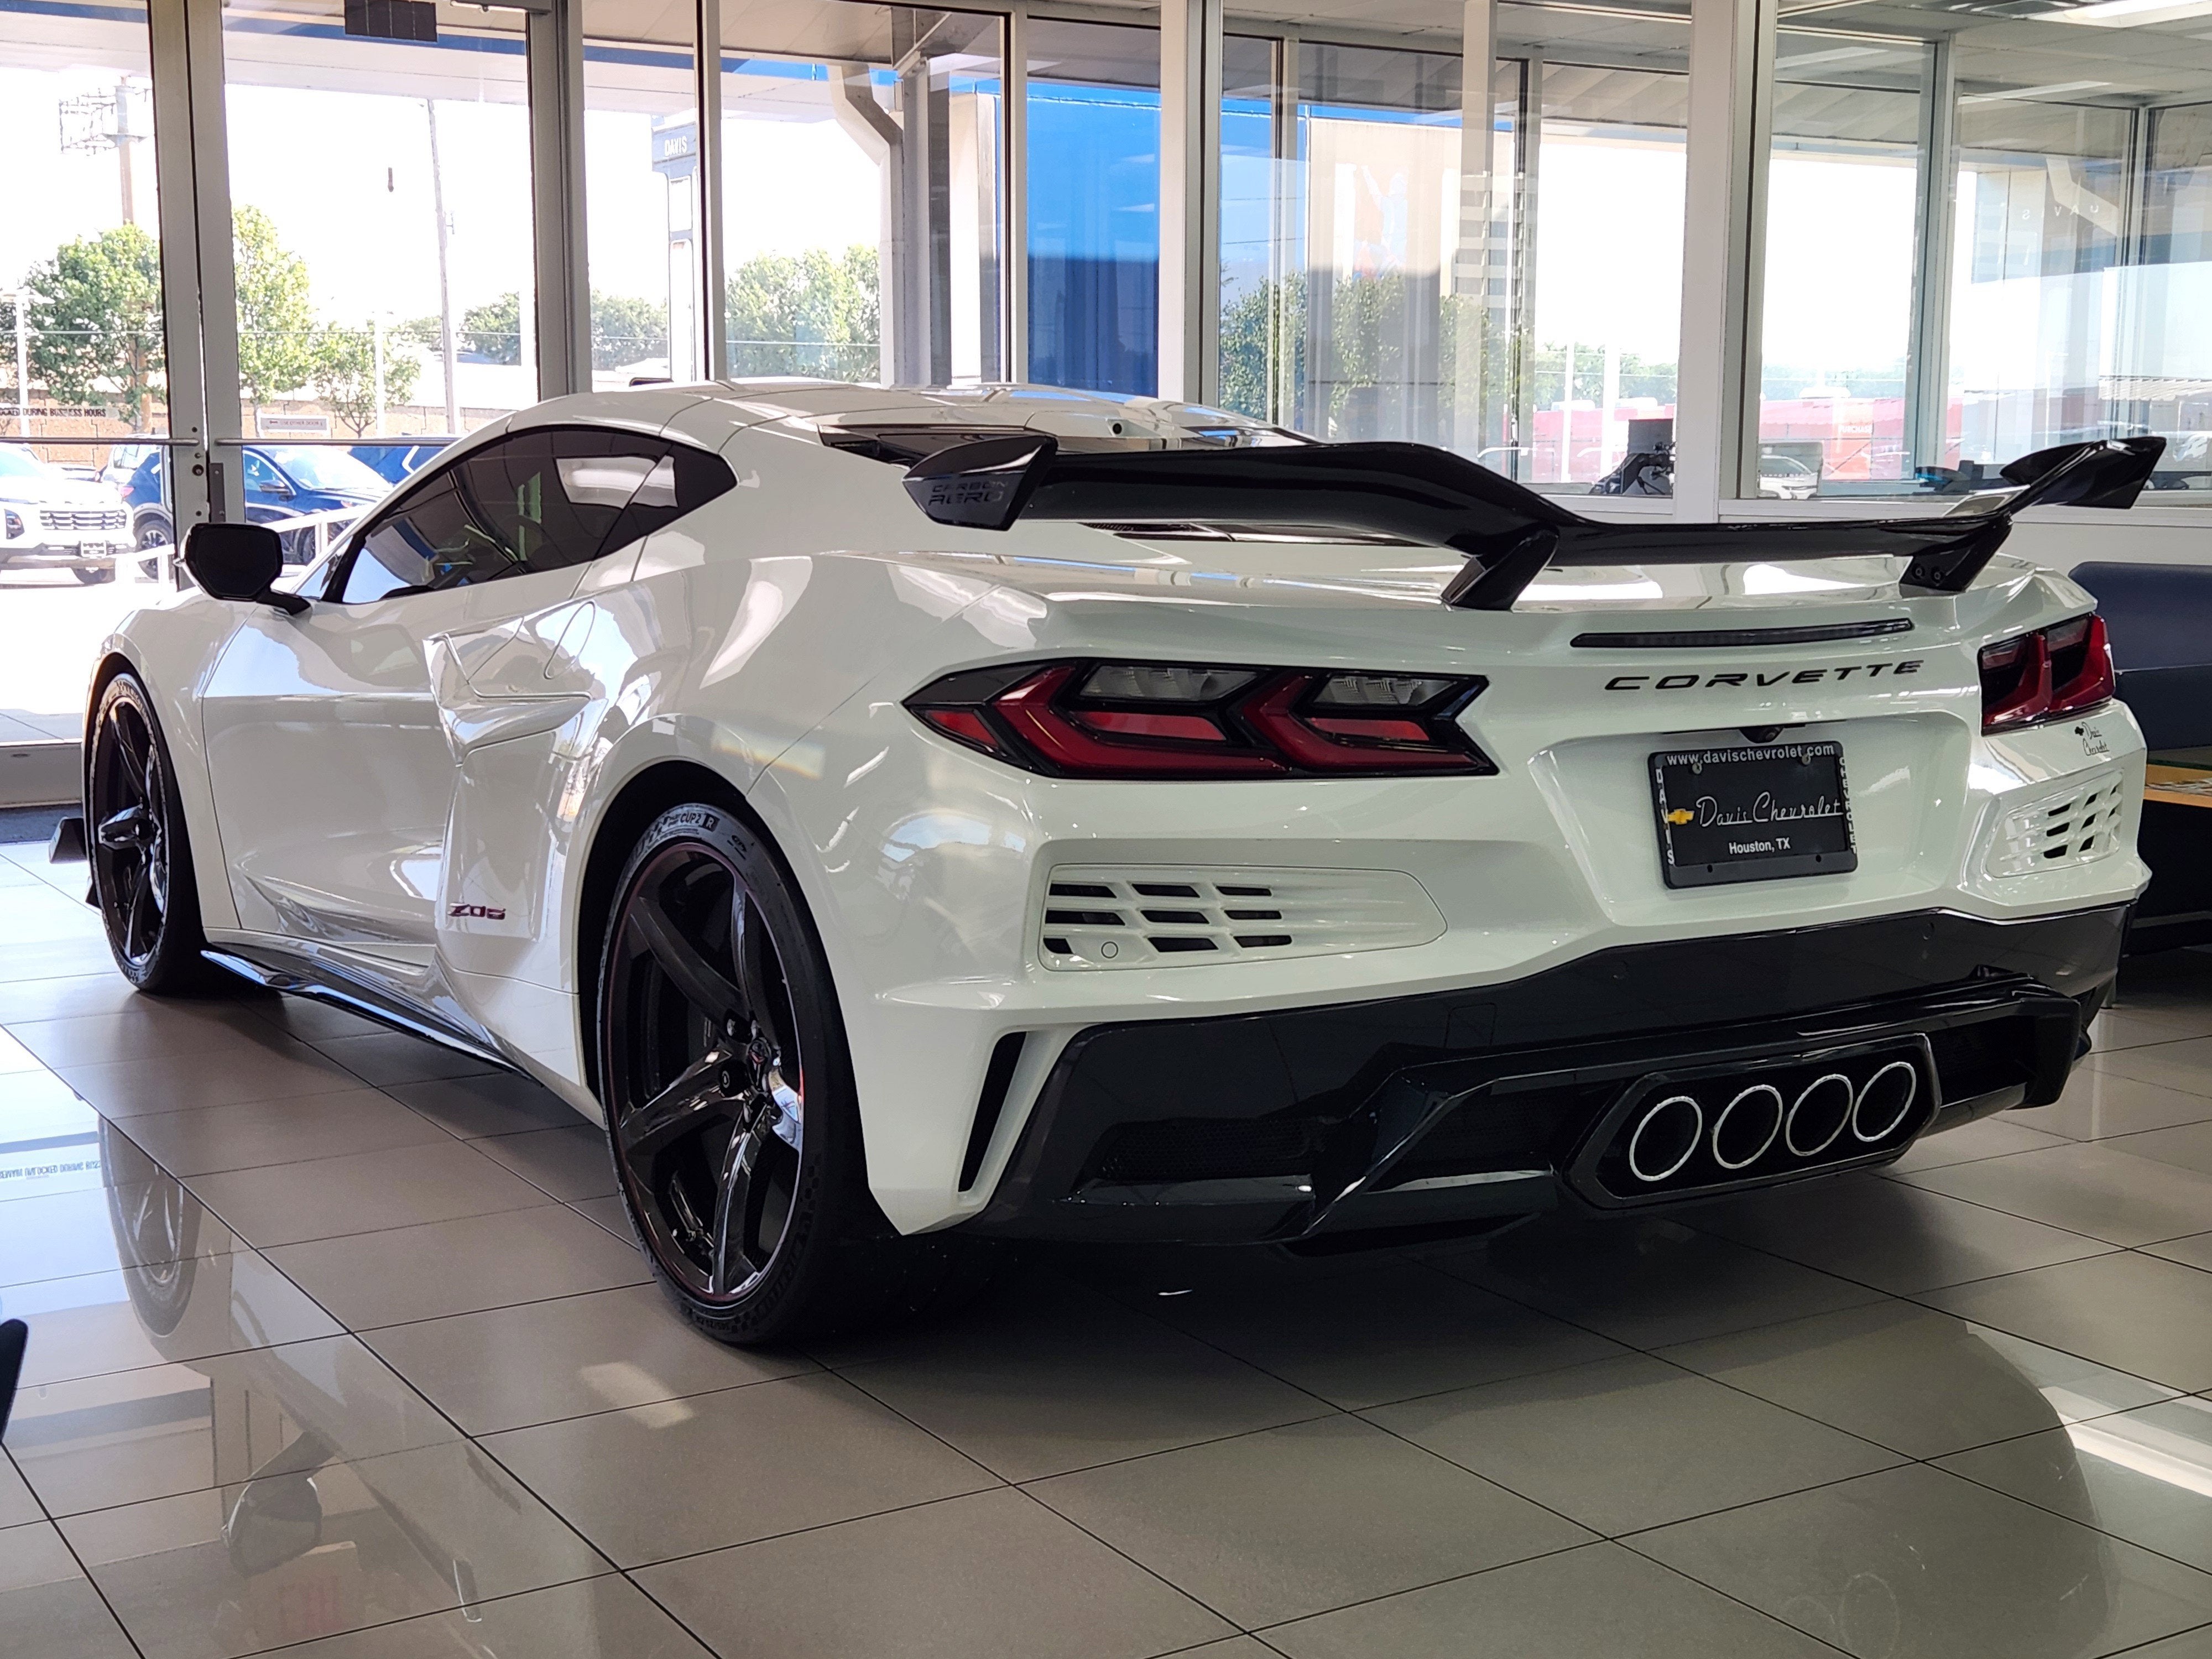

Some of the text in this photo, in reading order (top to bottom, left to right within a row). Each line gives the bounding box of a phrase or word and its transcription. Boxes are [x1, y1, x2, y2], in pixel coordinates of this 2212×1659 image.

[664, 135, 687, 156] DAVIS
[84, 408, 106, 418] HOURS
[1604, 660, 1924, 691] CORVETTE
[1666, 744, 1835, 765] www.davischevrolet.com
[1695, 791, 1844, 827] Davis Chevrolet
[1728, 837, 1791, 854] Houston, TX
